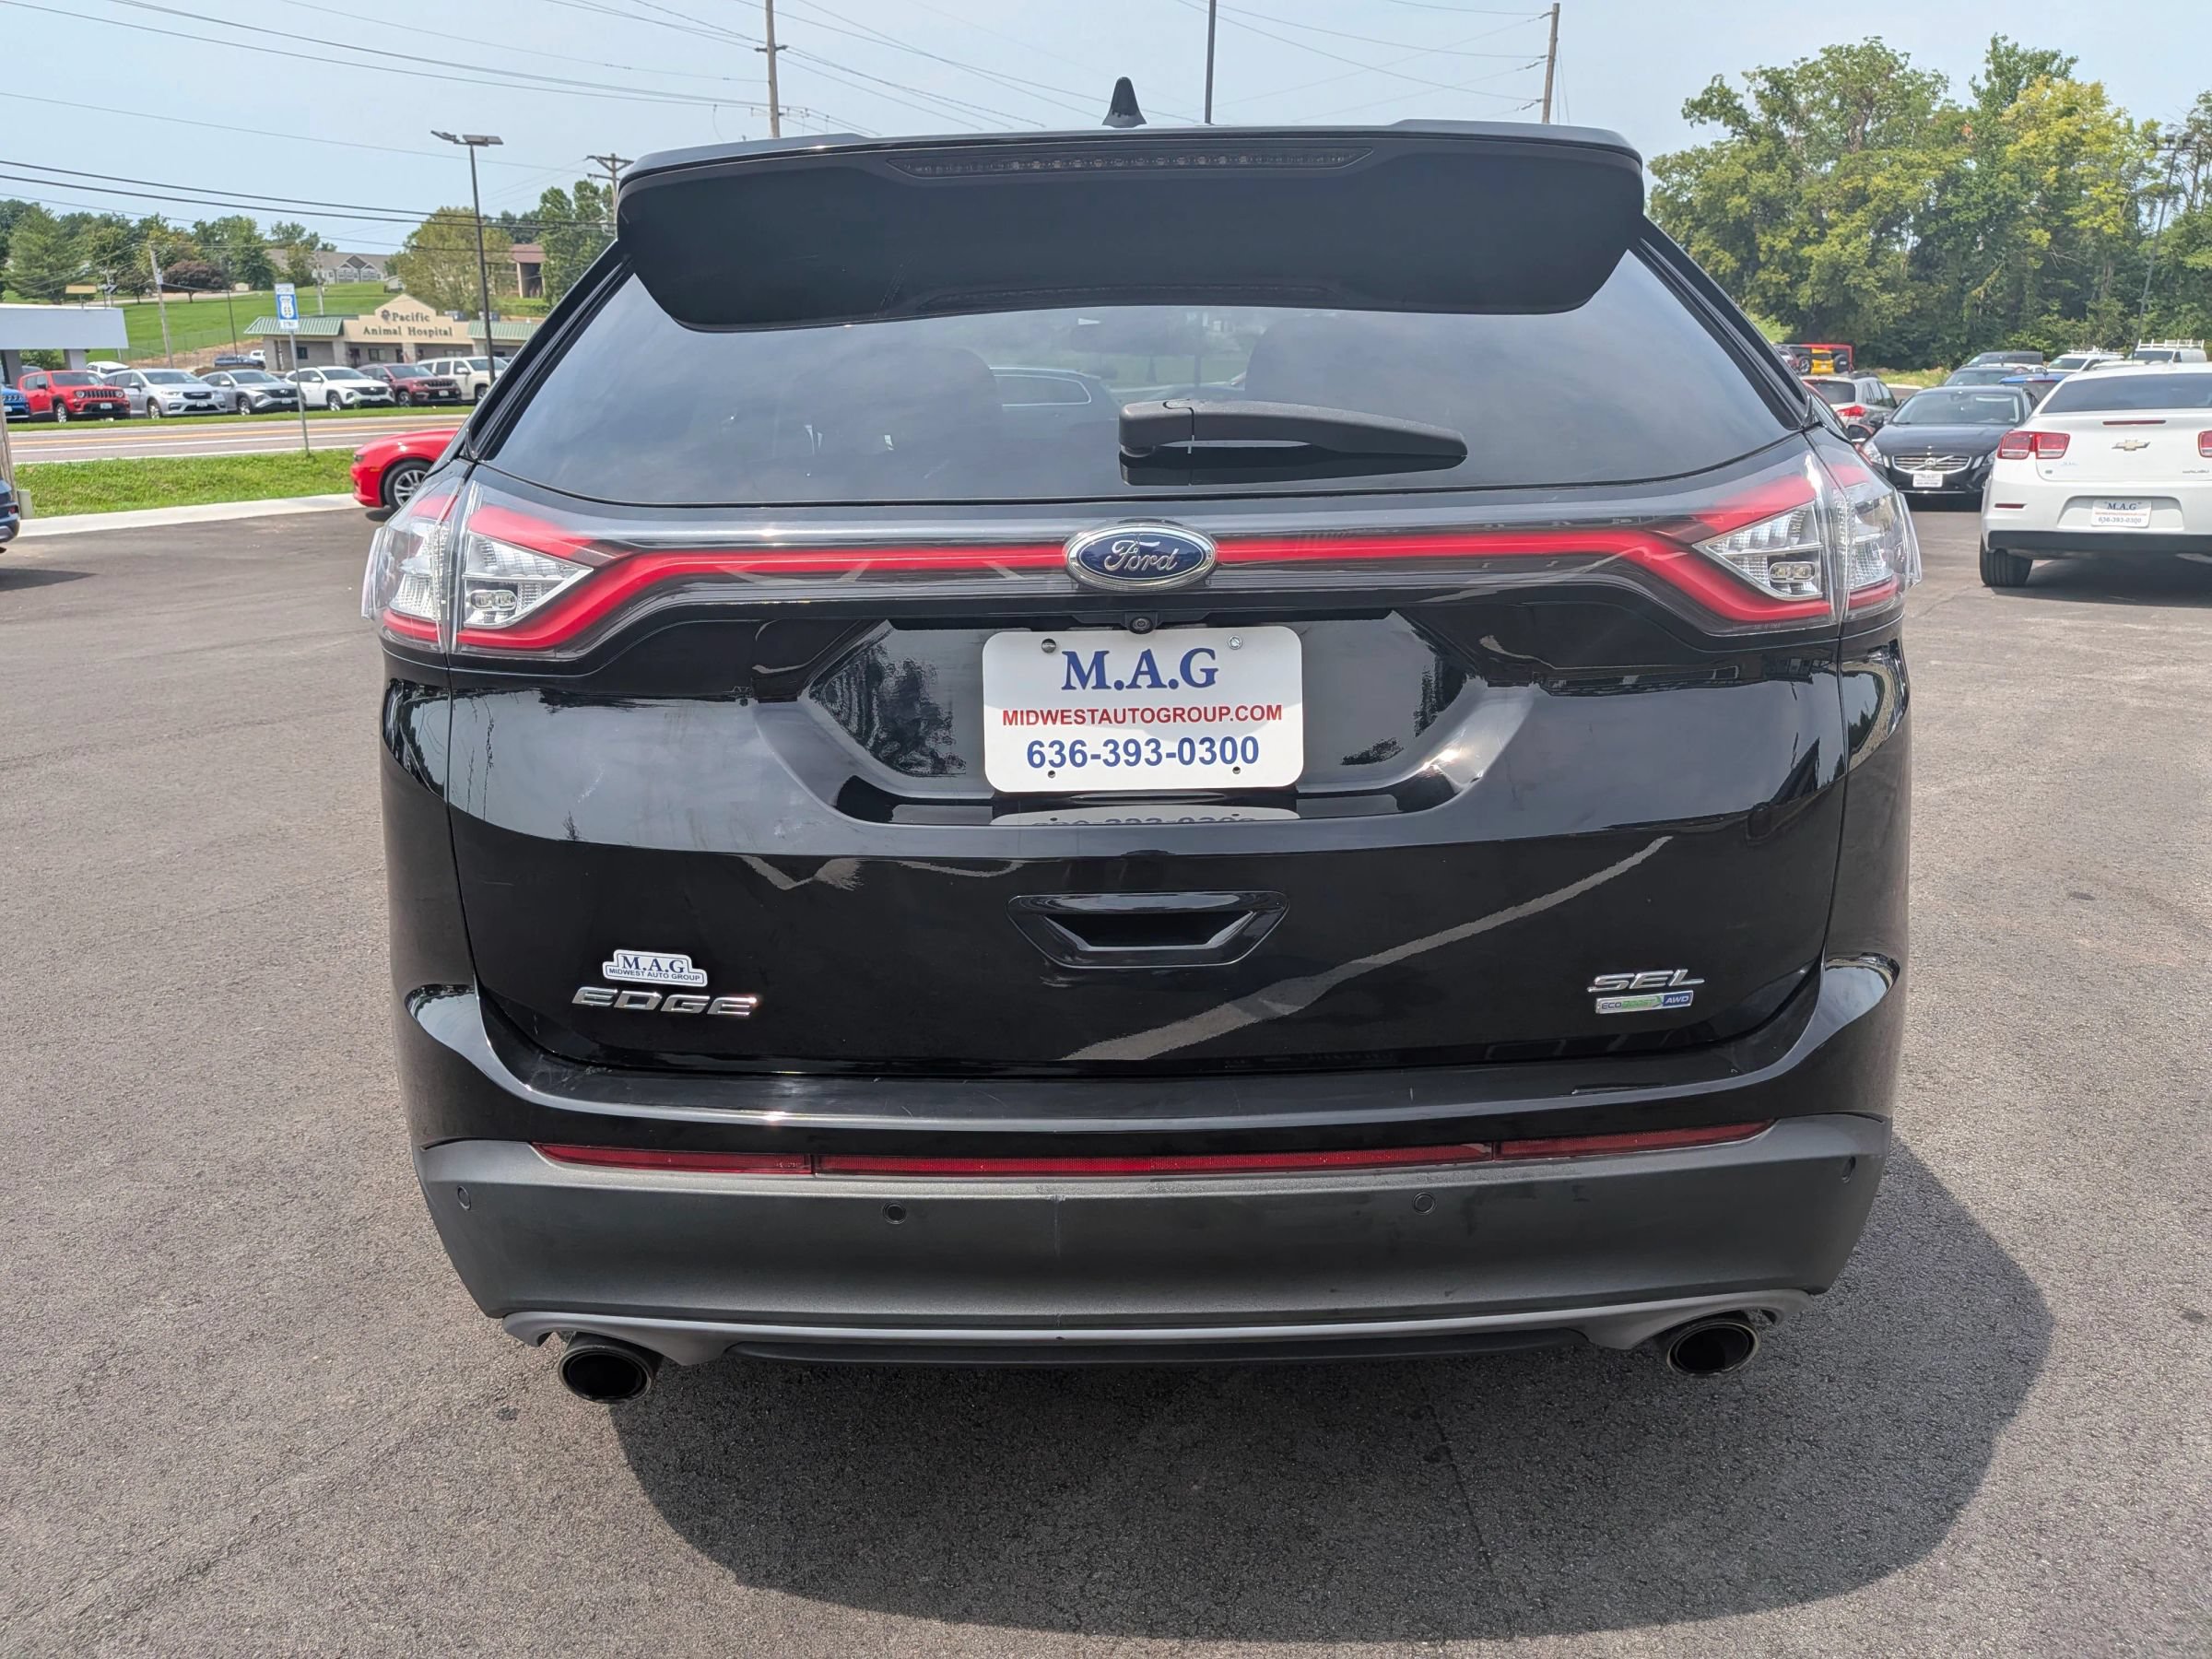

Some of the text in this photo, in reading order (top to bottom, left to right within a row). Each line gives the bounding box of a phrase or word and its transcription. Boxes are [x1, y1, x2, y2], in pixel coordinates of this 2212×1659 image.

[392, 312, 430, 322] Pacific
[363, 326, 453, 337] Animal Hospital
[1103, 539, 1179, 572] Ford
[1061, 647, 1218, 691] M.A.G
[1002, 704, 1282, 726] MIDWESTAUTOGROUP.COM
[1027, 736, 1259, 769] 636-393-0300
[608, 968, 700, 982] MIDWEST AUTO GROUP
[621, 955, 685, 973] M.A.G
[1587, 969, 1704, 993] SEL
[571, 986, 758, 1017] EDGE
[1665, 995, 1689, 1005] AWD
